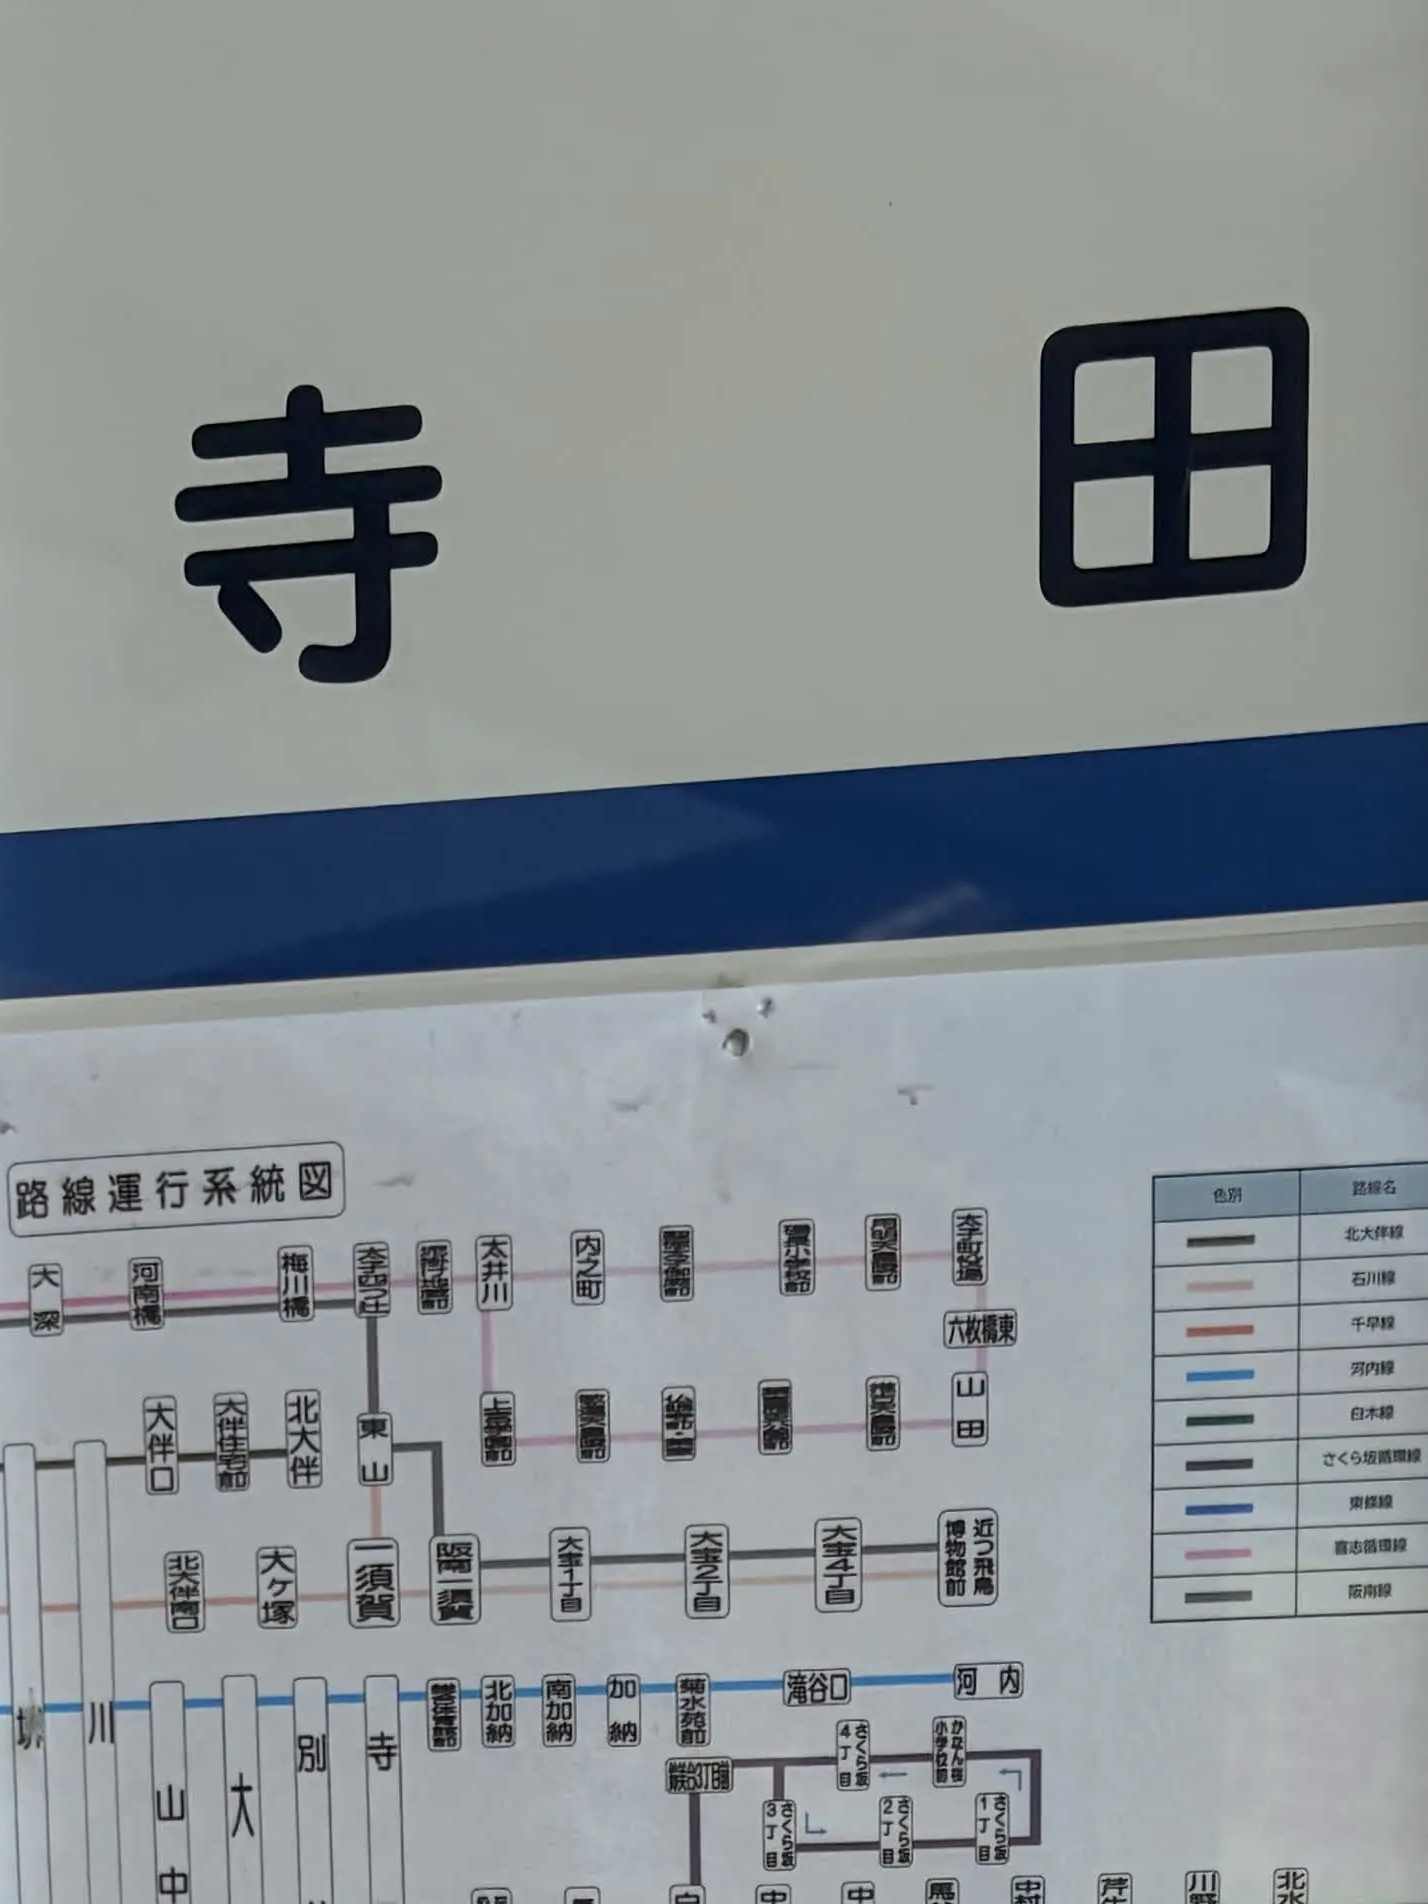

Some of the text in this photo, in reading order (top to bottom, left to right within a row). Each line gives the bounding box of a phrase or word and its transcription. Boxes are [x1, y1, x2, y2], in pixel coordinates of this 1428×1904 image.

[15, 1160, 333, 1220] 路線運行系統図
[1352, 1179, 1397, 1197] 路線名
[1344, 1224, 1405, 1242] 北大伴線
[132, 1262, 163, 1326] 河南橋
[281, 1252, 311, 1319] 梅川橋
[481, 1237, 509, 1304] 太井川
[576, 1235, 603, 1300] 内之町
[1351, 1270, 1397, 1287] 石川線
[1351, 1314, 1396, 1332] 千早線
[1350, 1359, 1395, 1377] 河内線
[288, 1395, 321, 1486] 北大伴
[956, 1376, 986, 1440] 山田
[1350, 1404, 1395, 1422] 白木線
[146, 1402, 177, 1492] 大伴口
[360, 1417, 390, 1483] 東山
[1322, 1447, 1422, 1468] さくら坂循環線
[556, 1536, 585, 1613] 大宝1丁目
[691, 1531, 723, 1613] 大宝2丁目
[822, 1525, 858, 1605] 大宝4丁目
[944, 1519, 967, 1597] 博物館前
[972, 1518, 995, 1597] 近つ飛鳥
[1334, 1537, 1408, 1555] 喜志循環線
[168, 1555, 201, 1631] 北大伴南口
[354, 1544, 396, 1623] 一須賀
[436, 1542, 474, 1621] 阪南一須賀
[1348, 1582, 1393, 1600] 阪南線
[484, 1679, 513, 1744] 北加納
[545, 1679, 574, 1744] 南加納
[608, 1678, 638, 1744] 加納
[678, 1677, 707, 1744] 菊水苑前
[786, 1671, 850, 1705] 滝谷口
[956, 1665, 1022, 1697] 河内
[882, 1800, 895, 1865] 2丁目
